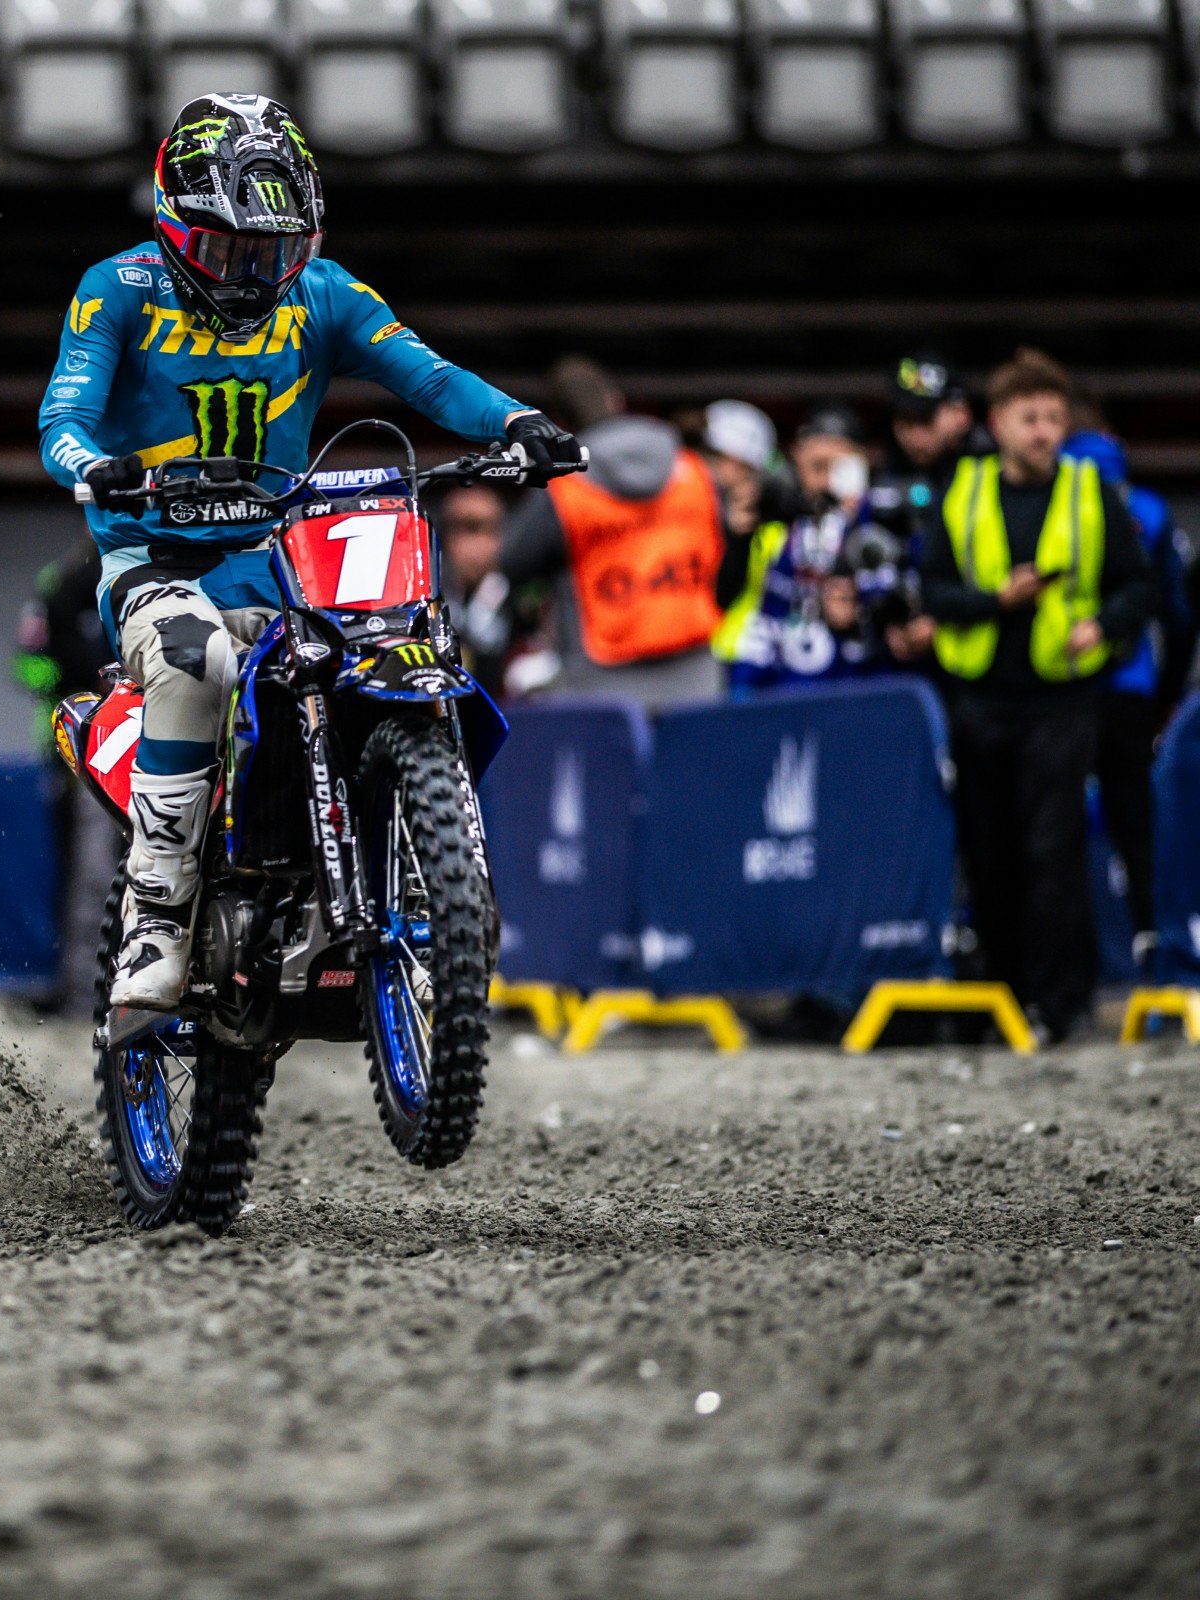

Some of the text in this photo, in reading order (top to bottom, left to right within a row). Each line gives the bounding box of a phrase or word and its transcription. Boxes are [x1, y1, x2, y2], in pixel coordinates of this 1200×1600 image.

[246, 213, 307, 227] MONSTER
[124, 270, 149, 284] 100%
[138, 302, 309, 356] THOR
[308, 468, 384, 488] PROTAPER
[481, 467, 520, 477] ARC
[307, 503, 332, 516] FIM
[360, 498, 407, 510] WSX
[327, 514, 398, 605] 1
[312, 762, 342, 880] DUNLOP
[319, 979, 354, 987] SPEED
